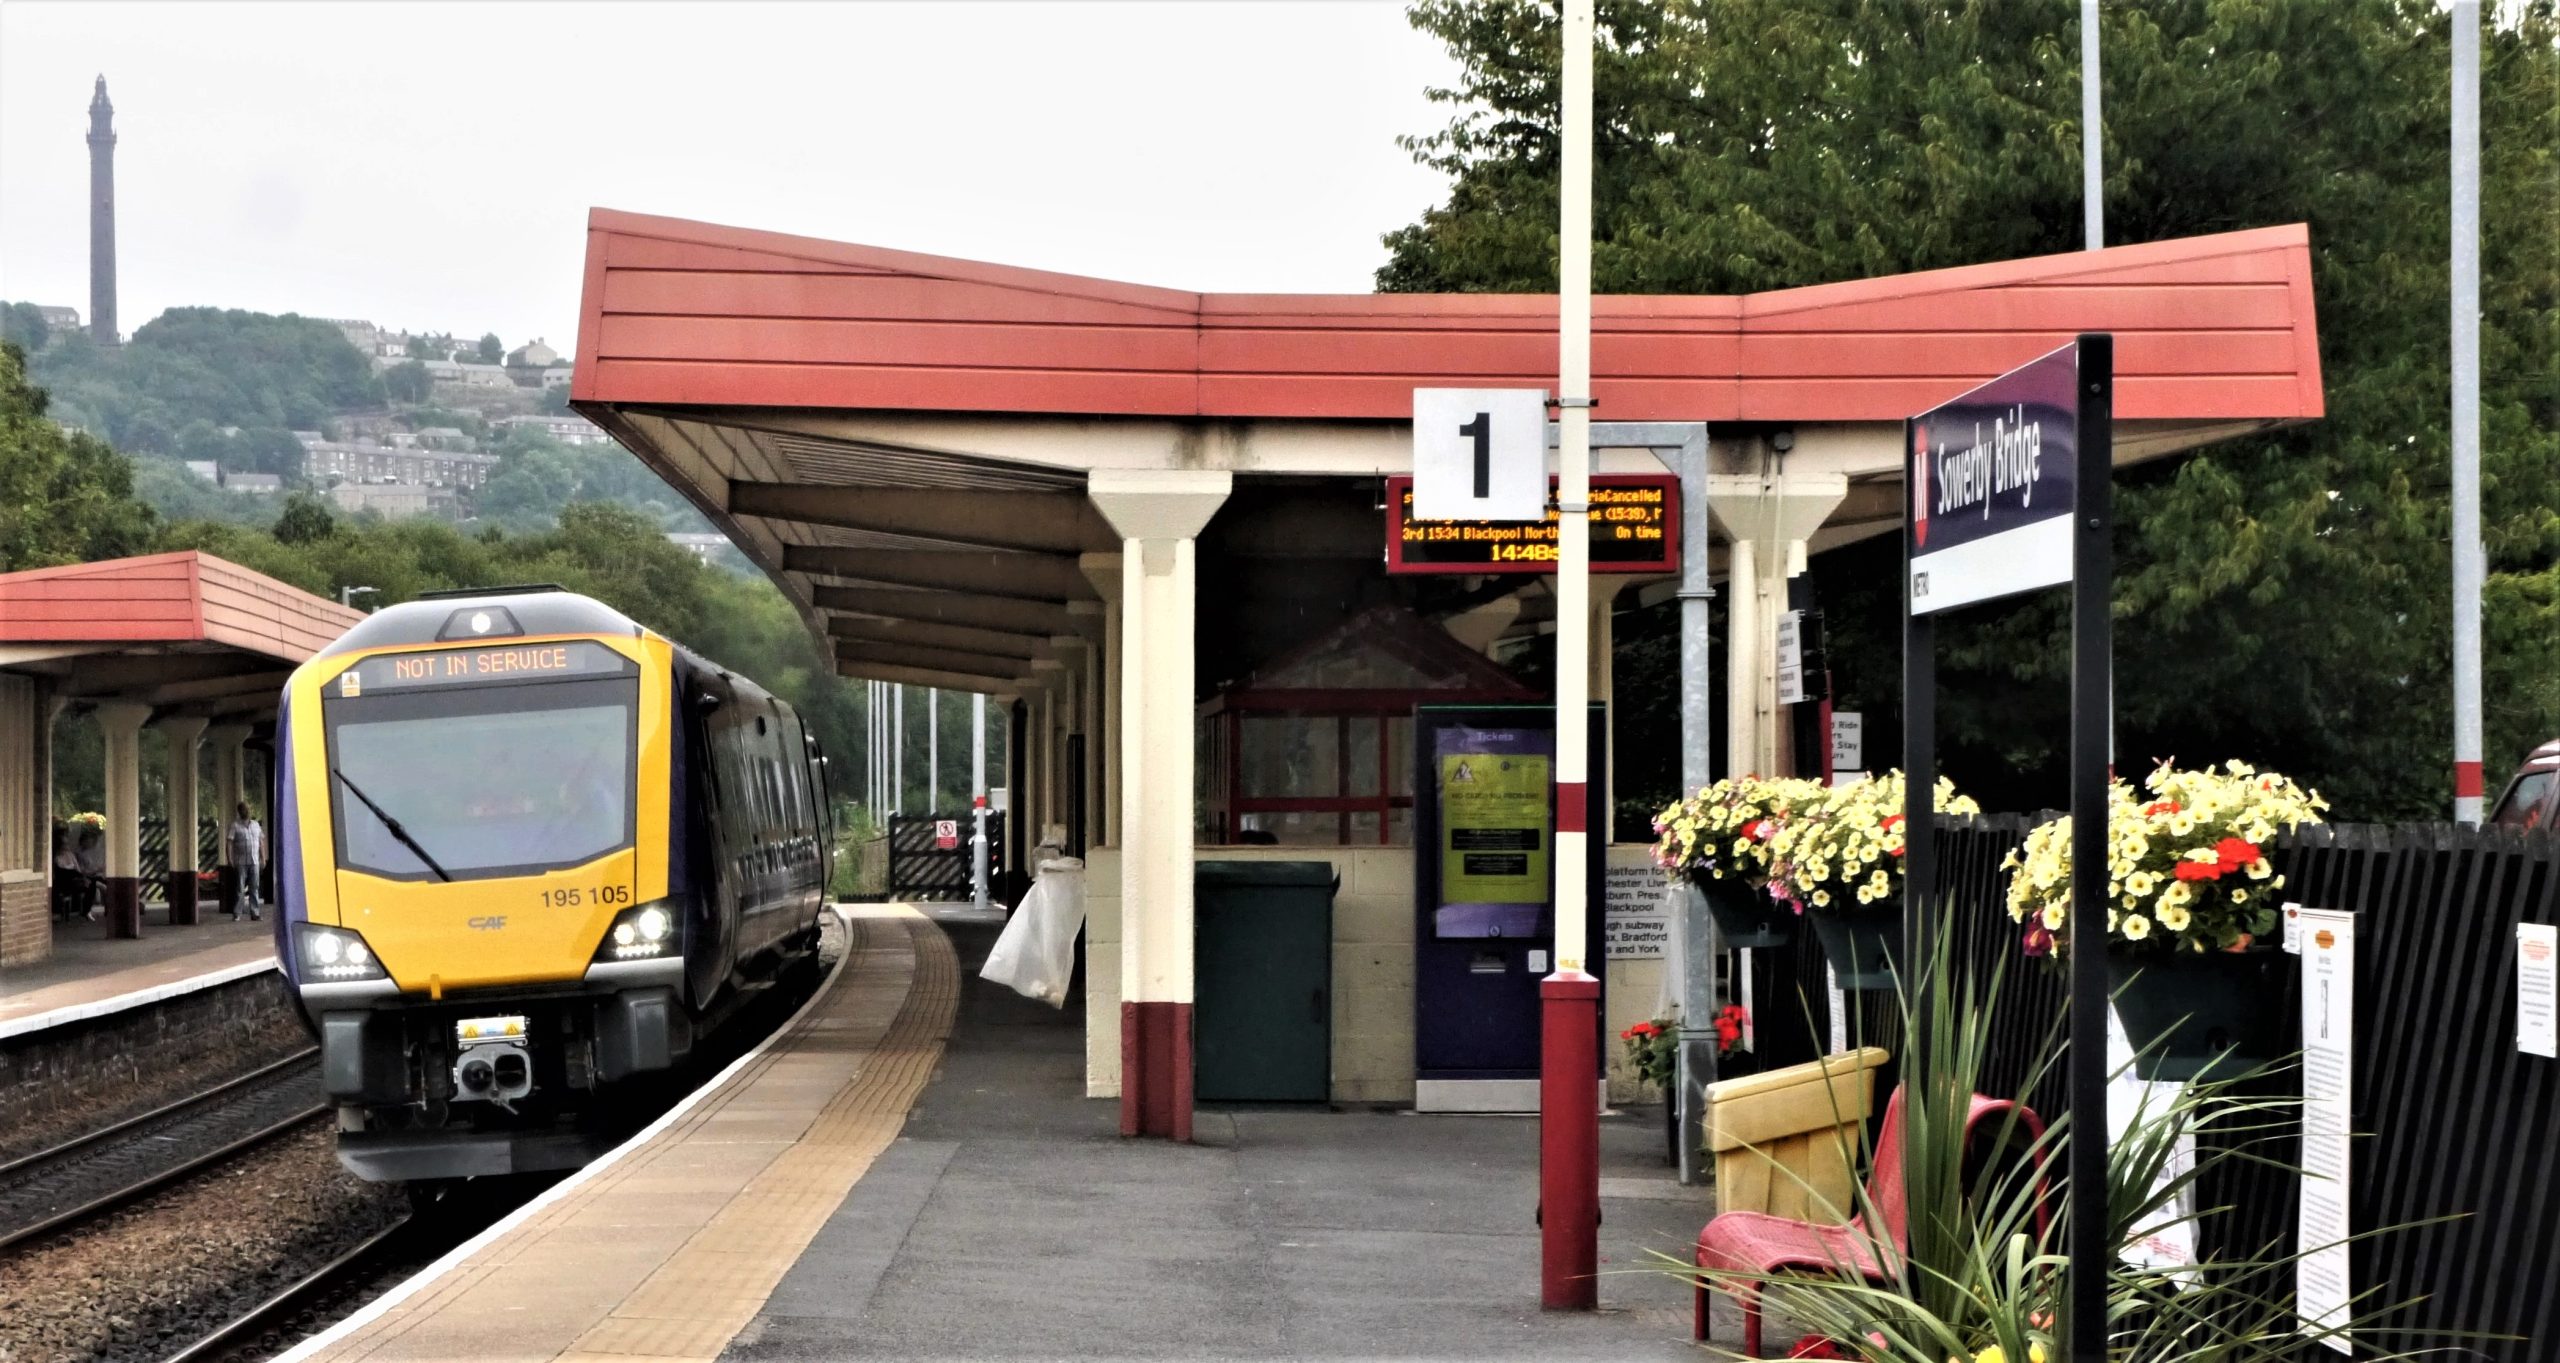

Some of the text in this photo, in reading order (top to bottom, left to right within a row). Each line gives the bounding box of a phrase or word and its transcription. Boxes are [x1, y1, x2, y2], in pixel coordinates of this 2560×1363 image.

[1460, 412, 1490, 498] 1
[1938, 403, 2041, 520] Sowerby Bridge
[1402, 528, 1424, 540] 3rd
[1428, 527, 1459, 540] 15:34
[1463, 527, 1521, 542] Blackpool
[1616, 526, 1631, 539] On
[1636, 526, 1662, 539] time
[396, 648, 568, 680] NOT IN SERVICE
[1838, 721, 1858, 729] Ride
[1476, 731, 1515, 742] Tickets
[1837, 741, 1857, 750] Stay
[541, 885, 629, 908] 195 105
[467, 915, 508, 931] CAF
[1625, 921, 1665, 931] subway
[1621, 933, 1668, 941] Bradford
[1615, 946, 1635, 954] and
[1638, 945, 1660, 953] York
